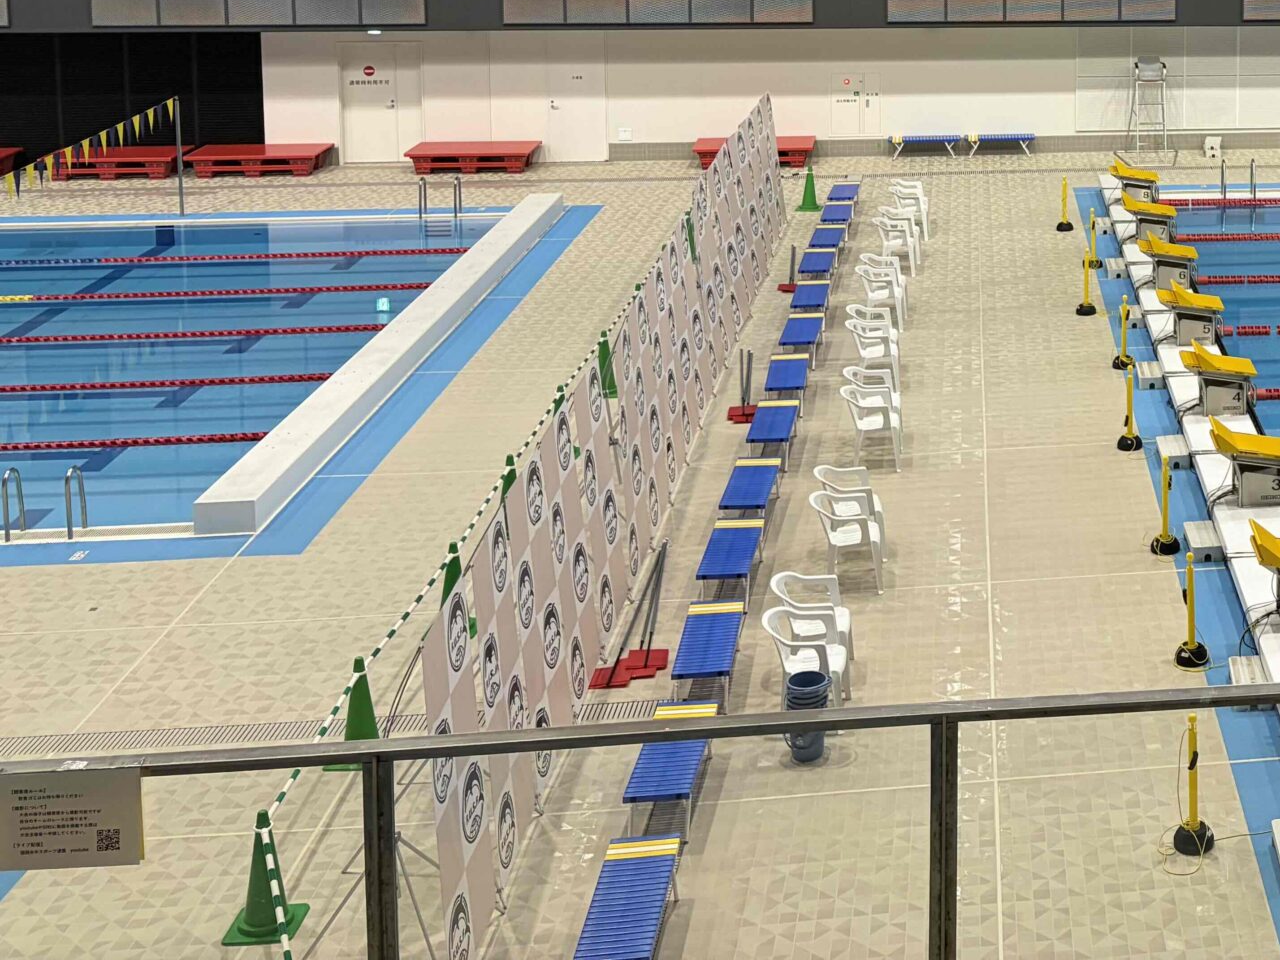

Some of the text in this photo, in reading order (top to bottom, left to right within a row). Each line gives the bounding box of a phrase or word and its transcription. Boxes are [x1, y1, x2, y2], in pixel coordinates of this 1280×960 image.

[1142, 190, 1150, 199] 8
[1159, 226, 1166, 236] 7
[1178, 270, 1186, 280] 6
[1202, 324, 1211, 334] 5
[1232, 391, 1242, 403] 4
